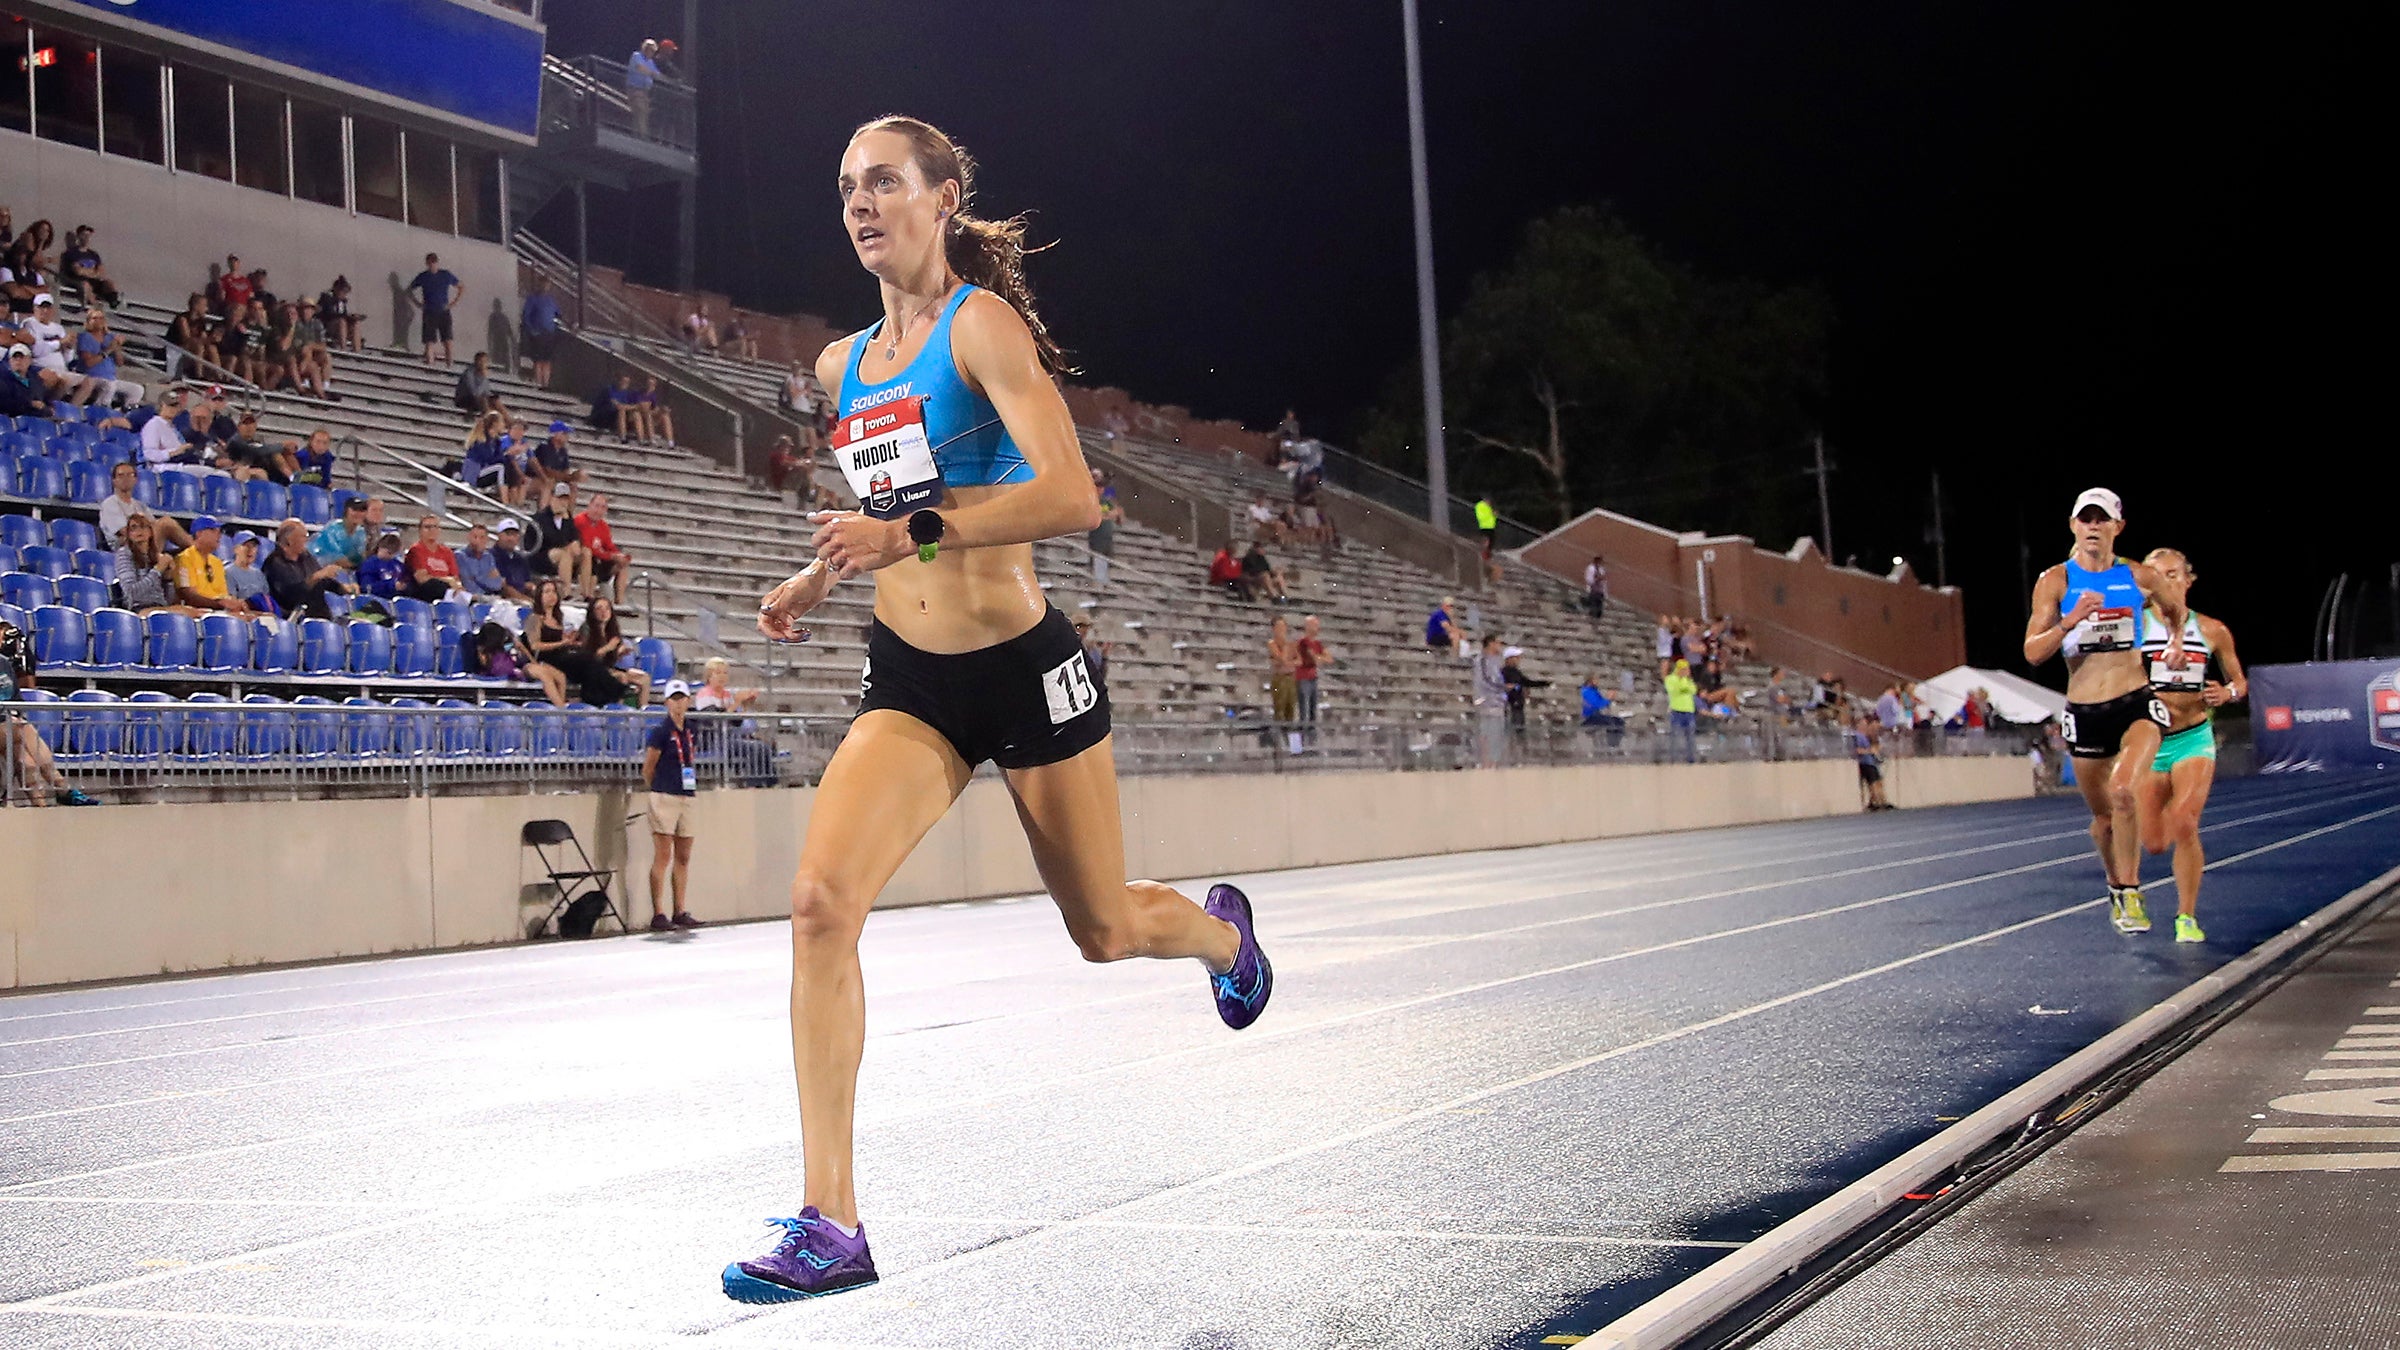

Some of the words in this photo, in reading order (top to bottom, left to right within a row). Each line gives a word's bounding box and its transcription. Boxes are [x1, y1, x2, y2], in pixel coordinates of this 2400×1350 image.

[849, 381, 913, 413] saucony
[865, 413, 897, 431] TOYOTA
[853, 439, 901, 471] HUDDLE
[1056, 655, 1092, 713] 15
[2294, 708, 2352, 723] TOYOTA
